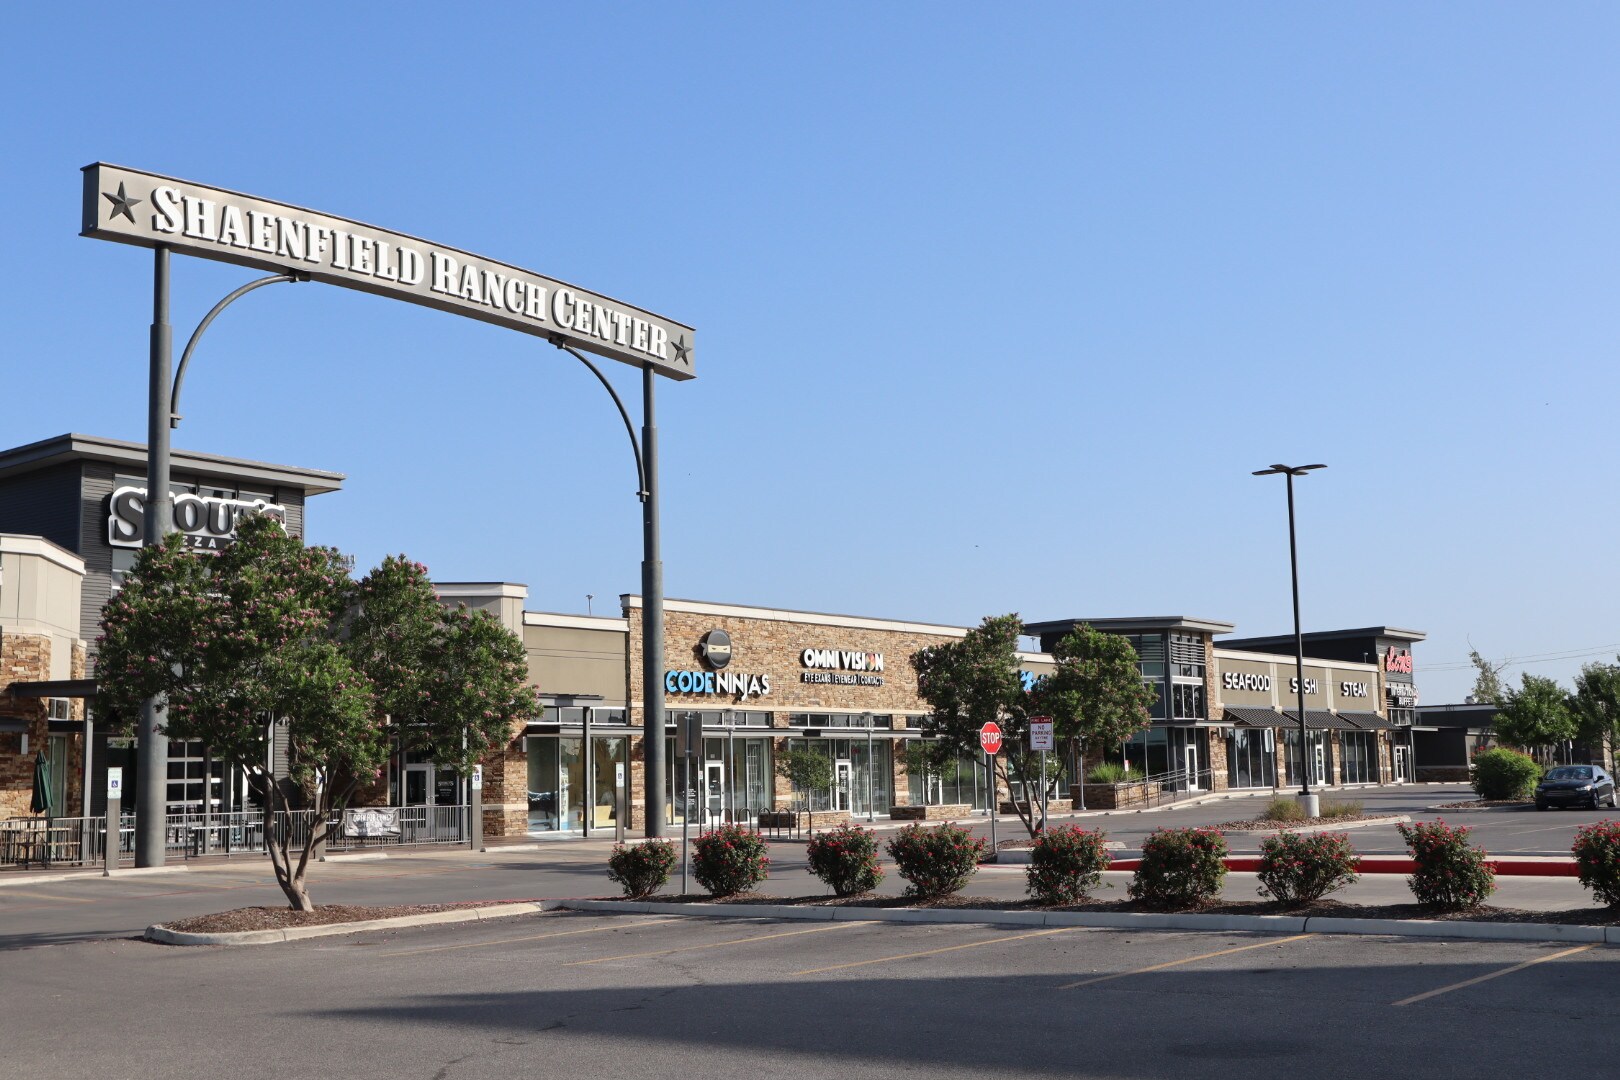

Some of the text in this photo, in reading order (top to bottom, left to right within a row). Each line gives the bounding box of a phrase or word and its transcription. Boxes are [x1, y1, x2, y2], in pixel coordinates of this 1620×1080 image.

[152, 185, 668, 360] SHAENFIELD RANCH CENTER
[182, 536, 217, 548] ZZA
[804, 648, 840, 668] OMNI
[665, 670, 770, 701] CODE NINJAS
[804, 673, 884, 686] EYE EXAMS EYEWEAR CONTACTS
[1225, 672, 1270, 691] SEAFOOD
[1291, 677, 1319, 694] SSHI
[1343, 681, 1368, 697] STEAK
[982, 732, 1000, 744] STOP
